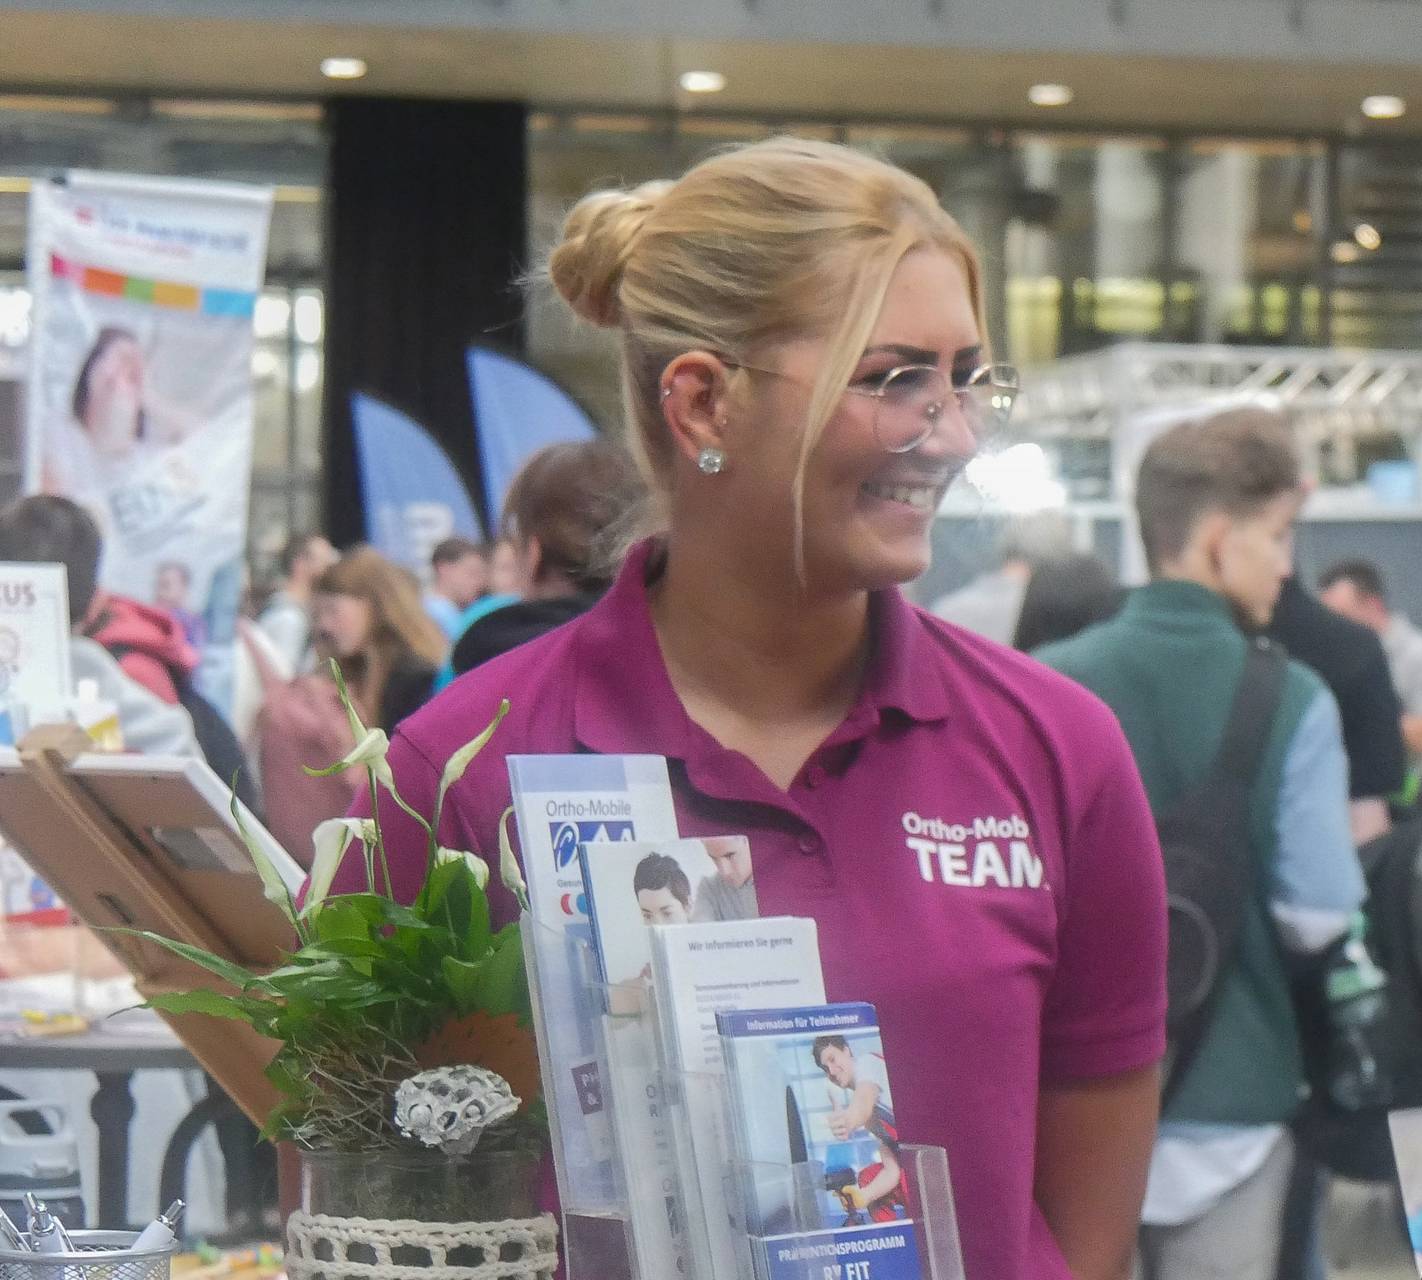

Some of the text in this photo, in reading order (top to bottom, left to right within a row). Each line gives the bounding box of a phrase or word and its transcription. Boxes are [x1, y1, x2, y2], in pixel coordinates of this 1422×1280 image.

[546, 799, 632, 817] Ortho-Mobile
[906, 836, 1044, 889] TEAM
[688, 942, 703, 951] Wir
[756, 937, 768, 947] Sie
[770, 937, 793, 949] gerne
[747, 1014, 859, 1031] Information für Teilnehmer
[846, 1261, 870, 1280] FIT
